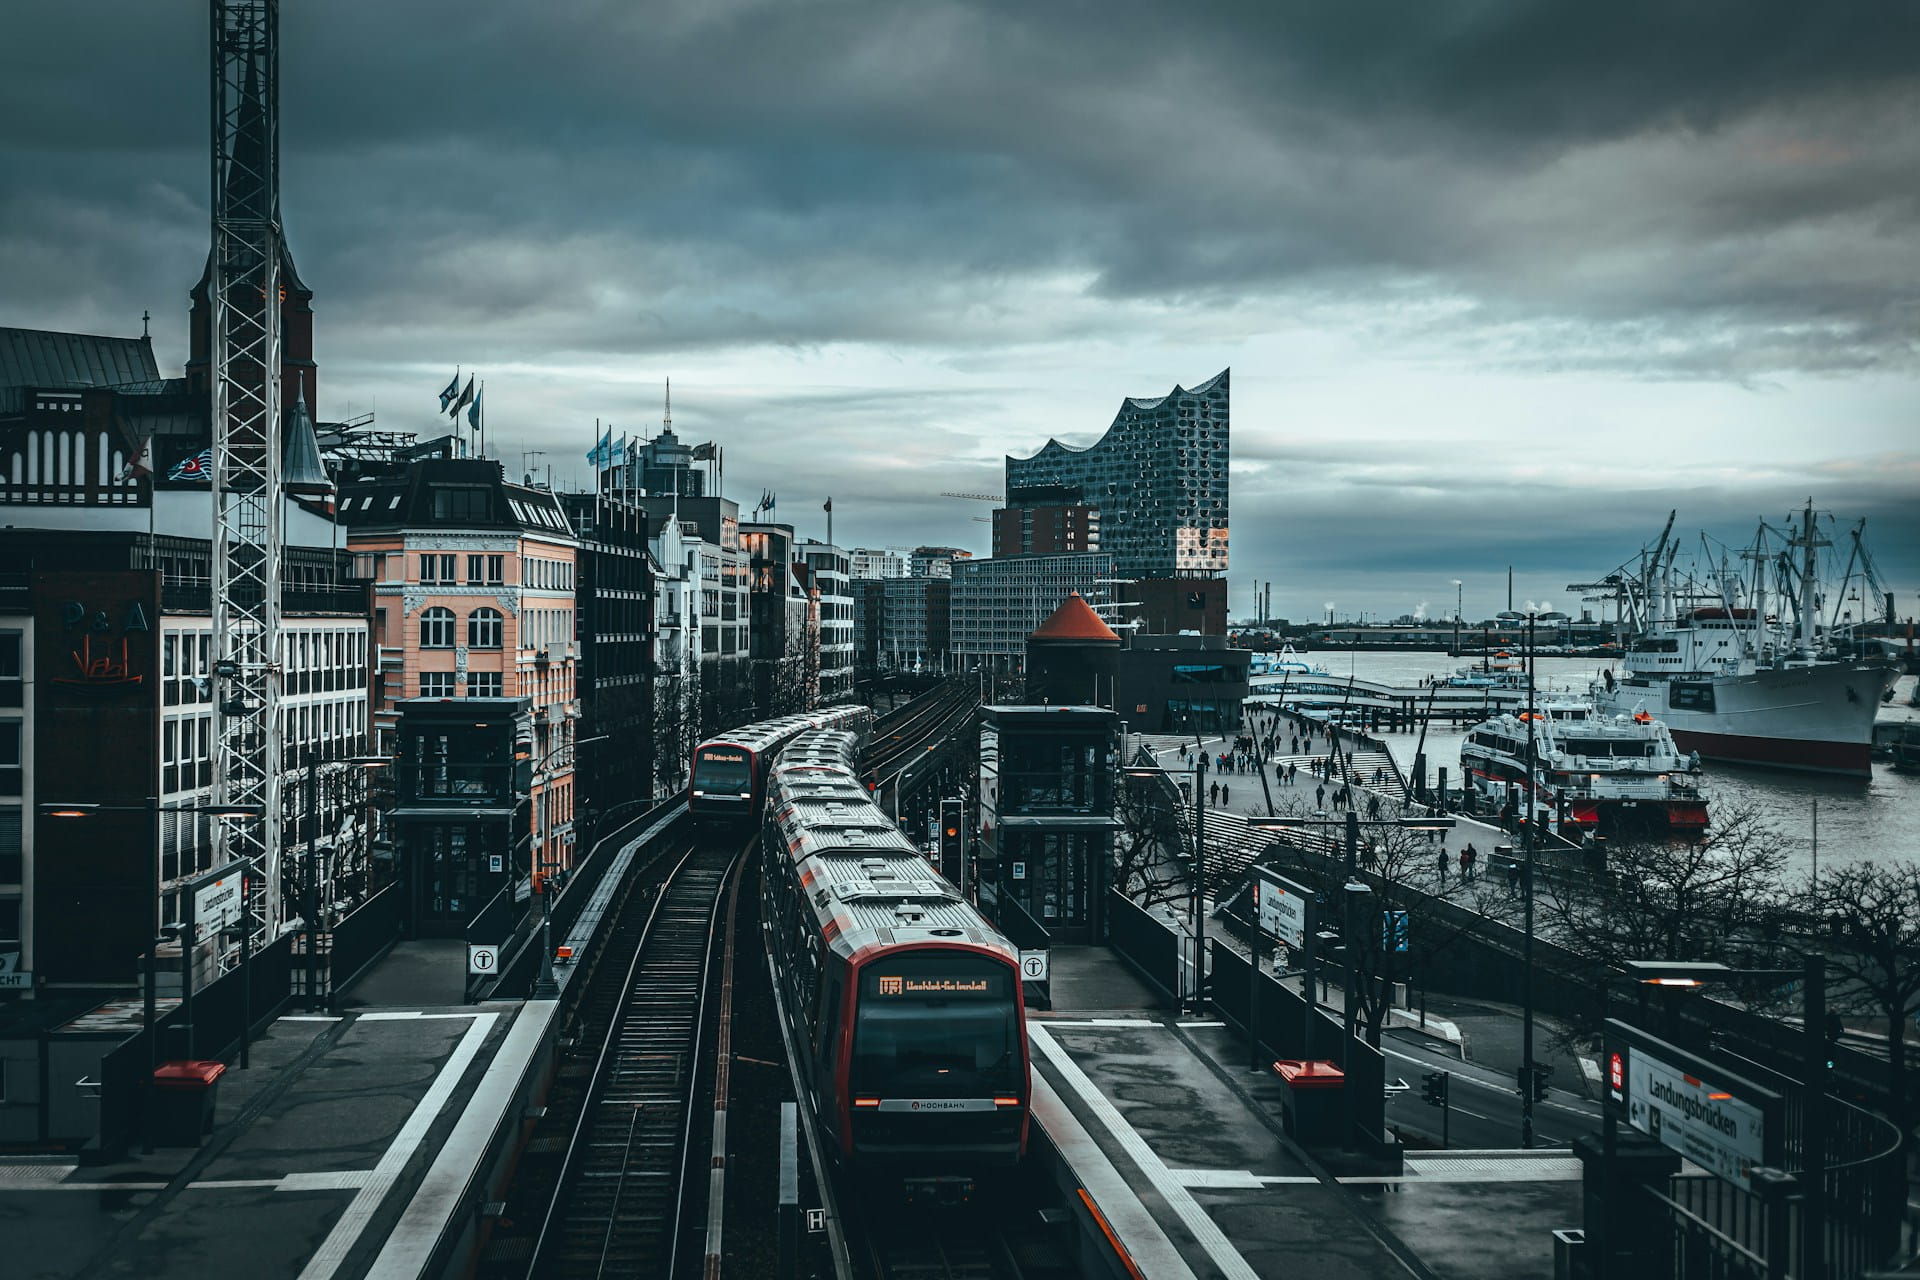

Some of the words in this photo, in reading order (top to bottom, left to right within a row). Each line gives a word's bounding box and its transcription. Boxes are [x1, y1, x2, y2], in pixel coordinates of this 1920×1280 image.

[126, 601, 149, 631] A
[1649, 1073, 1737, 1139] Landungsbrücken
[809, 1211, 824, 1230] H
